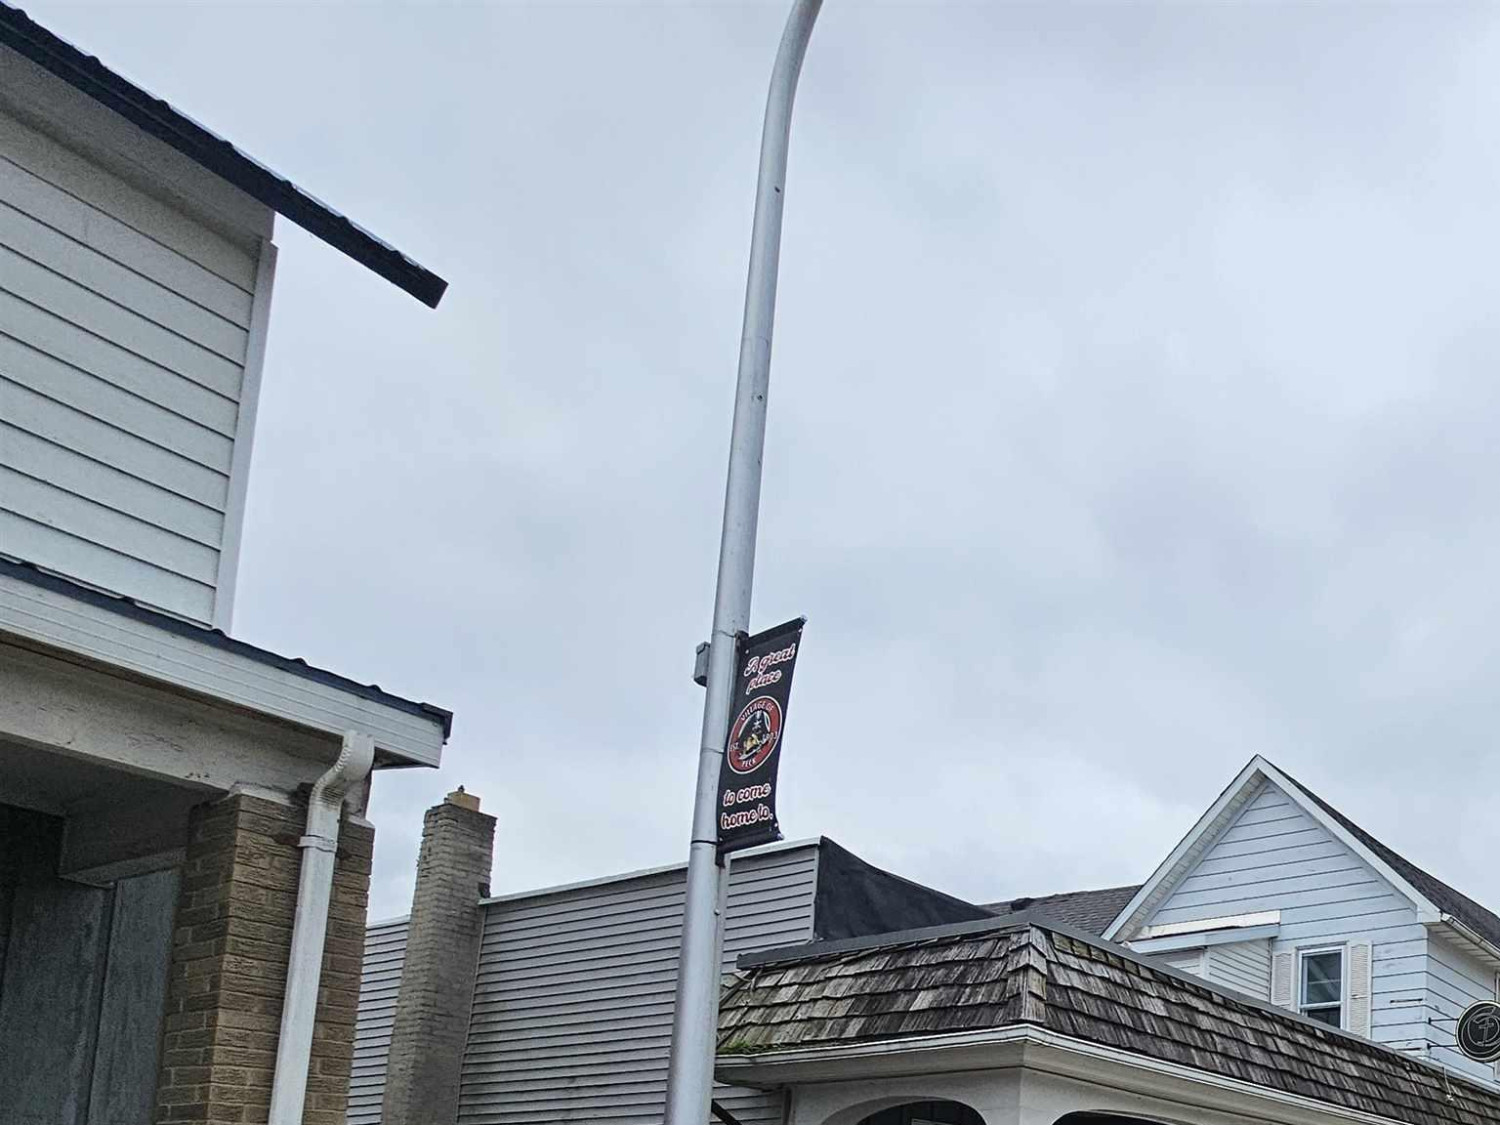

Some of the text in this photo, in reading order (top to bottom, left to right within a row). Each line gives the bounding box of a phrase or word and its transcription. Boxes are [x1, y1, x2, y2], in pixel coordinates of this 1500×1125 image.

[757, 642, 796, 675] great
[745, 669, 782, 695] place
[741, 701, 765, 721] VILLAGE
[742, 758, 757, 768] PECK
[723, 783, 772, 806] to come
[721, 812, 758, 829] home
